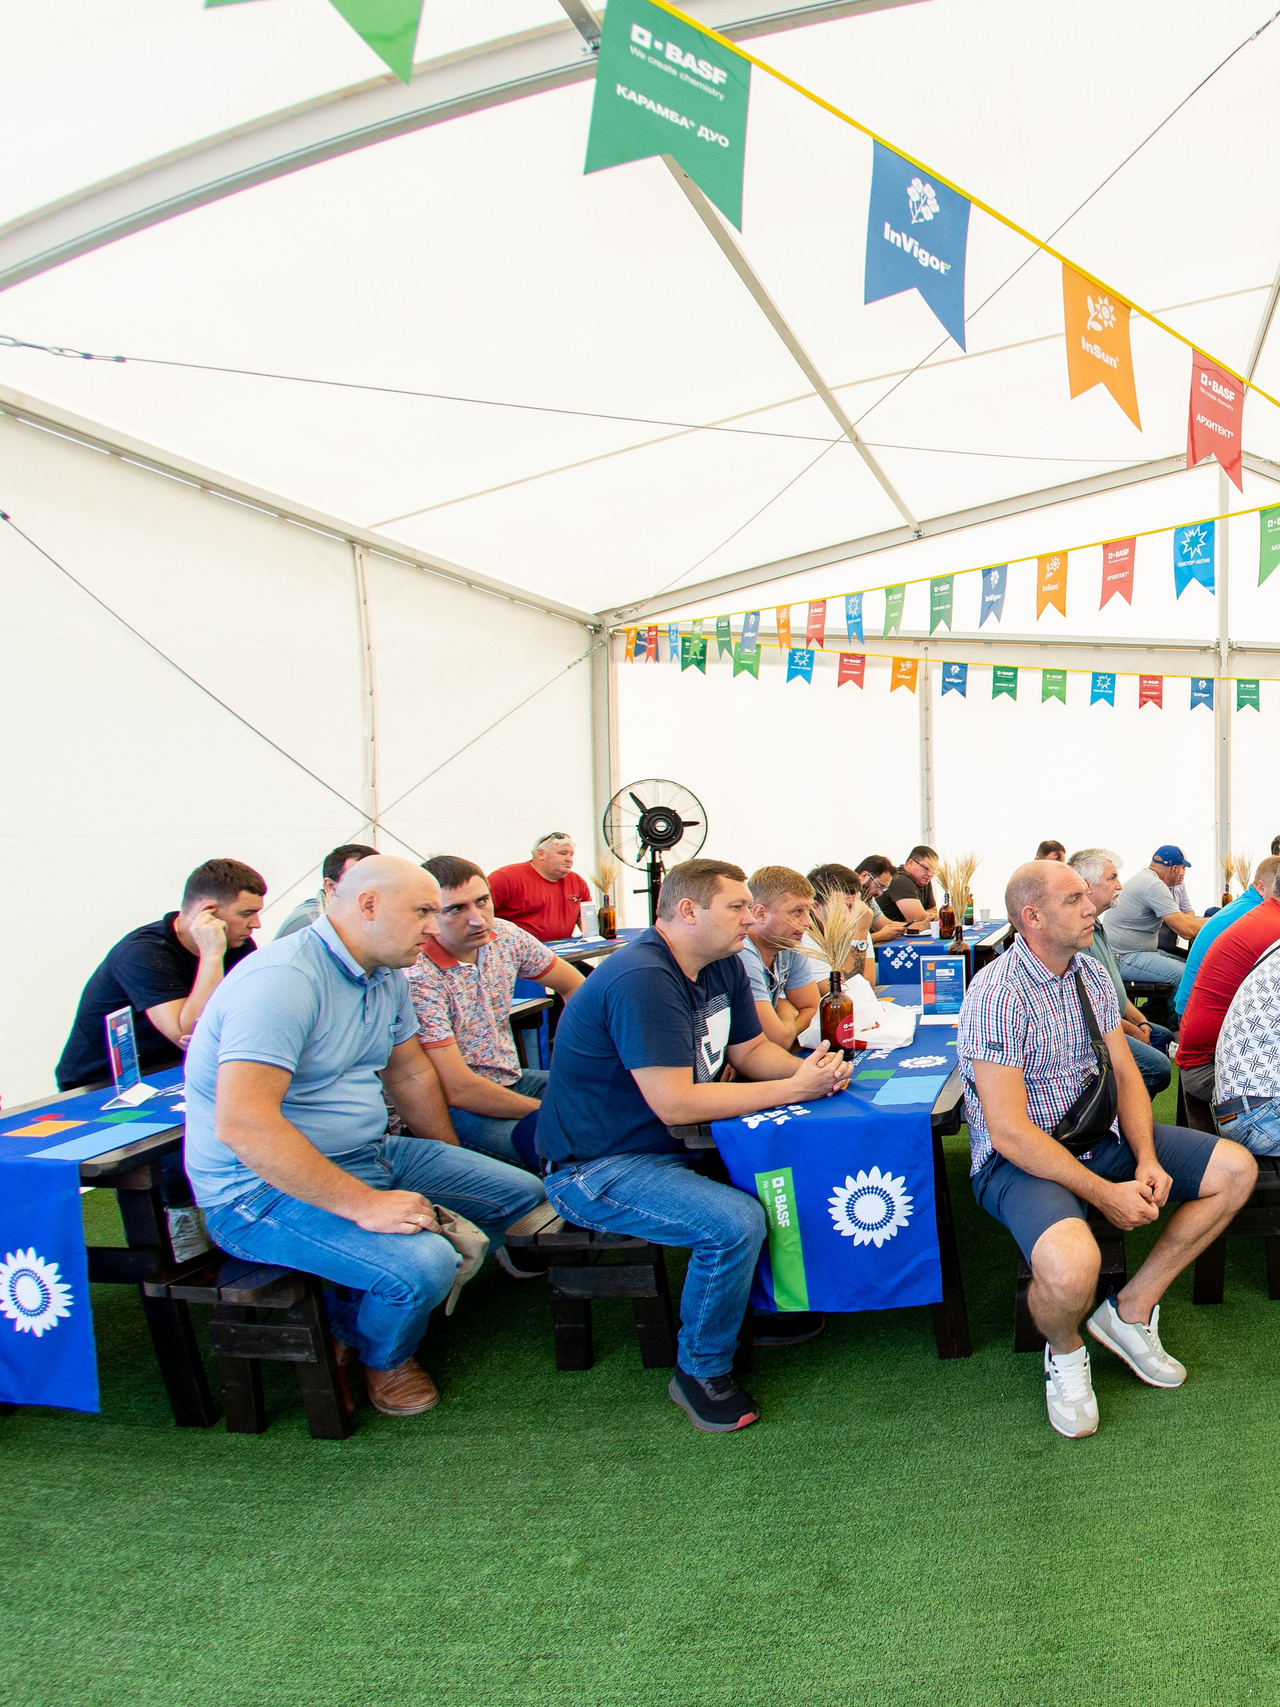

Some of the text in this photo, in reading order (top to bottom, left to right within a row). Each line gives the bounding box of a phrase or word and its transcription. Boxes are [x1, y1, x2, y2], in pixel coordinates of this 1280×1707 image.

[630, 44, 725, 101] We create chemistry
[666, 42, 727, 84] BASF
[697, 124, 729, 148] ДУО
[1212, 381, 1235, 402] BASF
[1115, 549, 1130, 559] BASF
[774, 1193, 790, 1228] BASF
